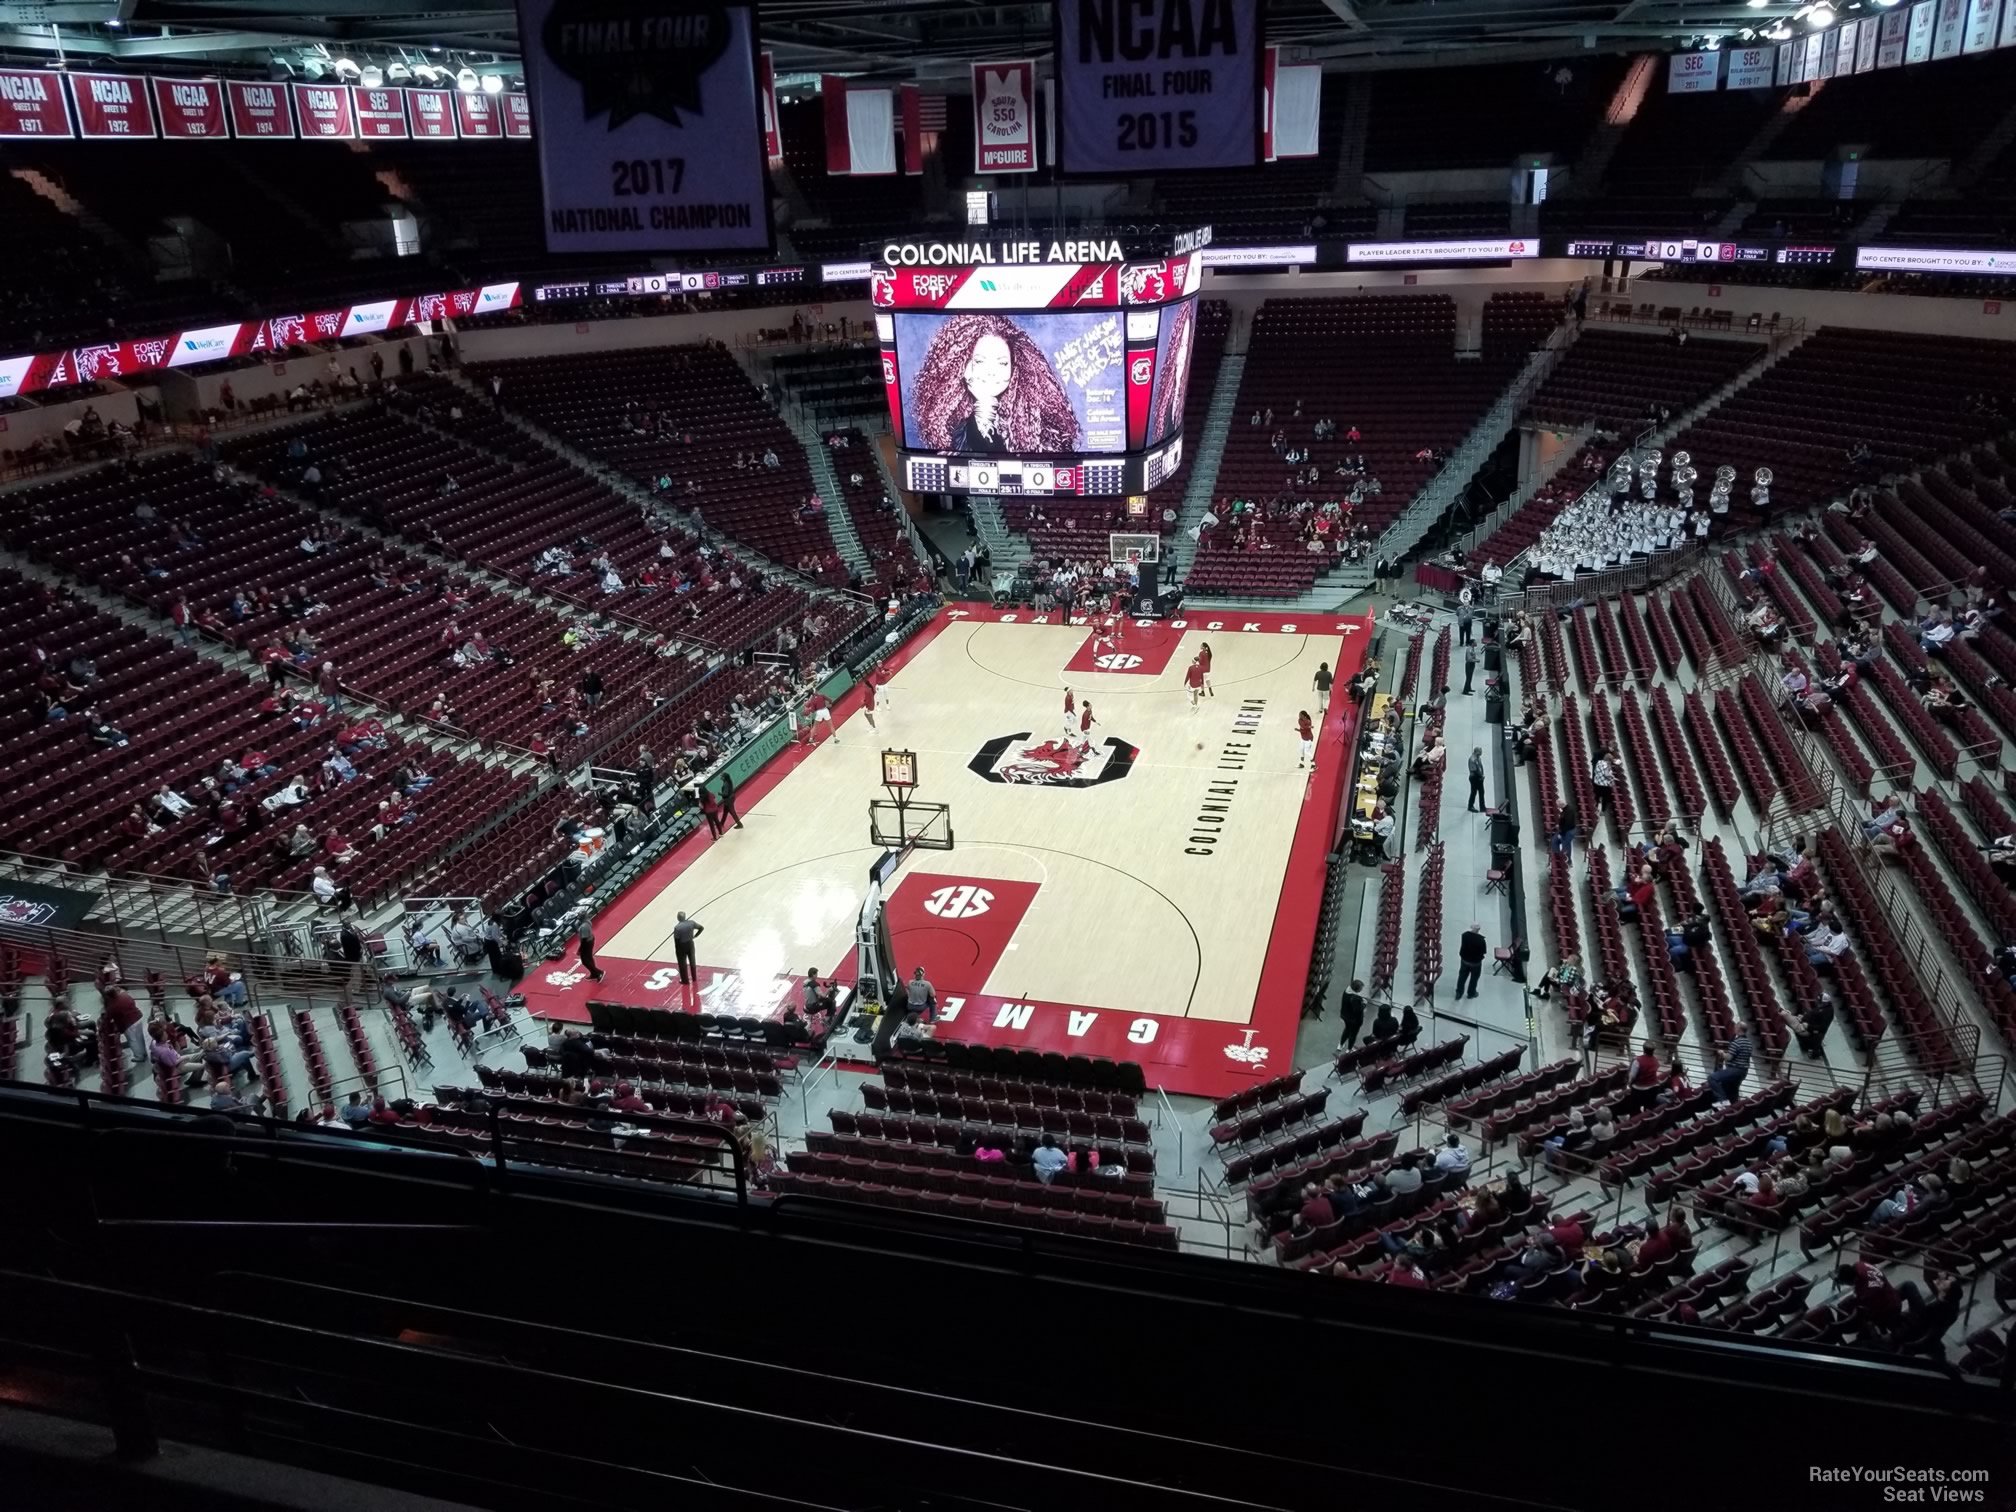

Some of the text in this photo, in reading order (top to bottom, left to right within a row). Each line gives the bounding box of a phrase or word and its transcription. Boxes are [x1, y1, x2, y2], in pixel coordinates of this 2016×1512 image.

[561, 14, 711, 53] FINAL FOUR
[1078, 0, 1238, 64] NCAA
[1684, 56, 1704, 70] SEC
[1743, 52, 1761, 65] SEC
[0, 76, 48, 101] NCAA
[90, 80, 133, 104] NCAA
[1103, 69, 1212, 99] FINAL FOUR
[172, 84, 210, 106] NCAA
[242, 87, 276, 107] NCAA
[307, 90, 338, 110] NCAA
[369, 92, 389, 110] SEC
[417, 94, 443, 112] NCAA
[991, 96, 1017, 108] SOUTH
[465, 95, 489, 112] NCAA
[993, 108, 1016, 121] 550
[19, 118, 43, 132] 1971
[107, 120, 130, 133] 1972
[186, 123, 207, 134] 1973
[256, 122, 273, 133] 1974
[987, 121, 1023, 137] CAROLINA
[1117, 111, 1198, 150] 2015
[612, 159, 685, 196] 2017
[551, 204, 752, 233] NATIONAL CHAMPION
[1174, 233, 1195, 256] COLONIAL
[1667, 244, 1676, 256] 0
[1703, 246, 1712, 258] 0
[883, 240, 1124, 266] COLONIAL LIFE ARENA
[651, 279, 660, 291] 0
[688, 276, 697, 288] 0
[913, 274, 957, 287] FOREV
[914, 286, 928, 296] TO
[314, 312, 343, 326] FOREV
[134, 339, 225, 355] FOREV WellCare
[136, 353, 148, 363] TO
[978, 471, 989, 485] 0
[1033, 472, 1044, 486] 0
[1001, 485, 1021, 494] 25:11
[1094, 653, 1143, 670] SEC
[1184, 699, 1267, 856] COLONIAL LIFE ARENA
[923, 885, 996, 918] SEC
